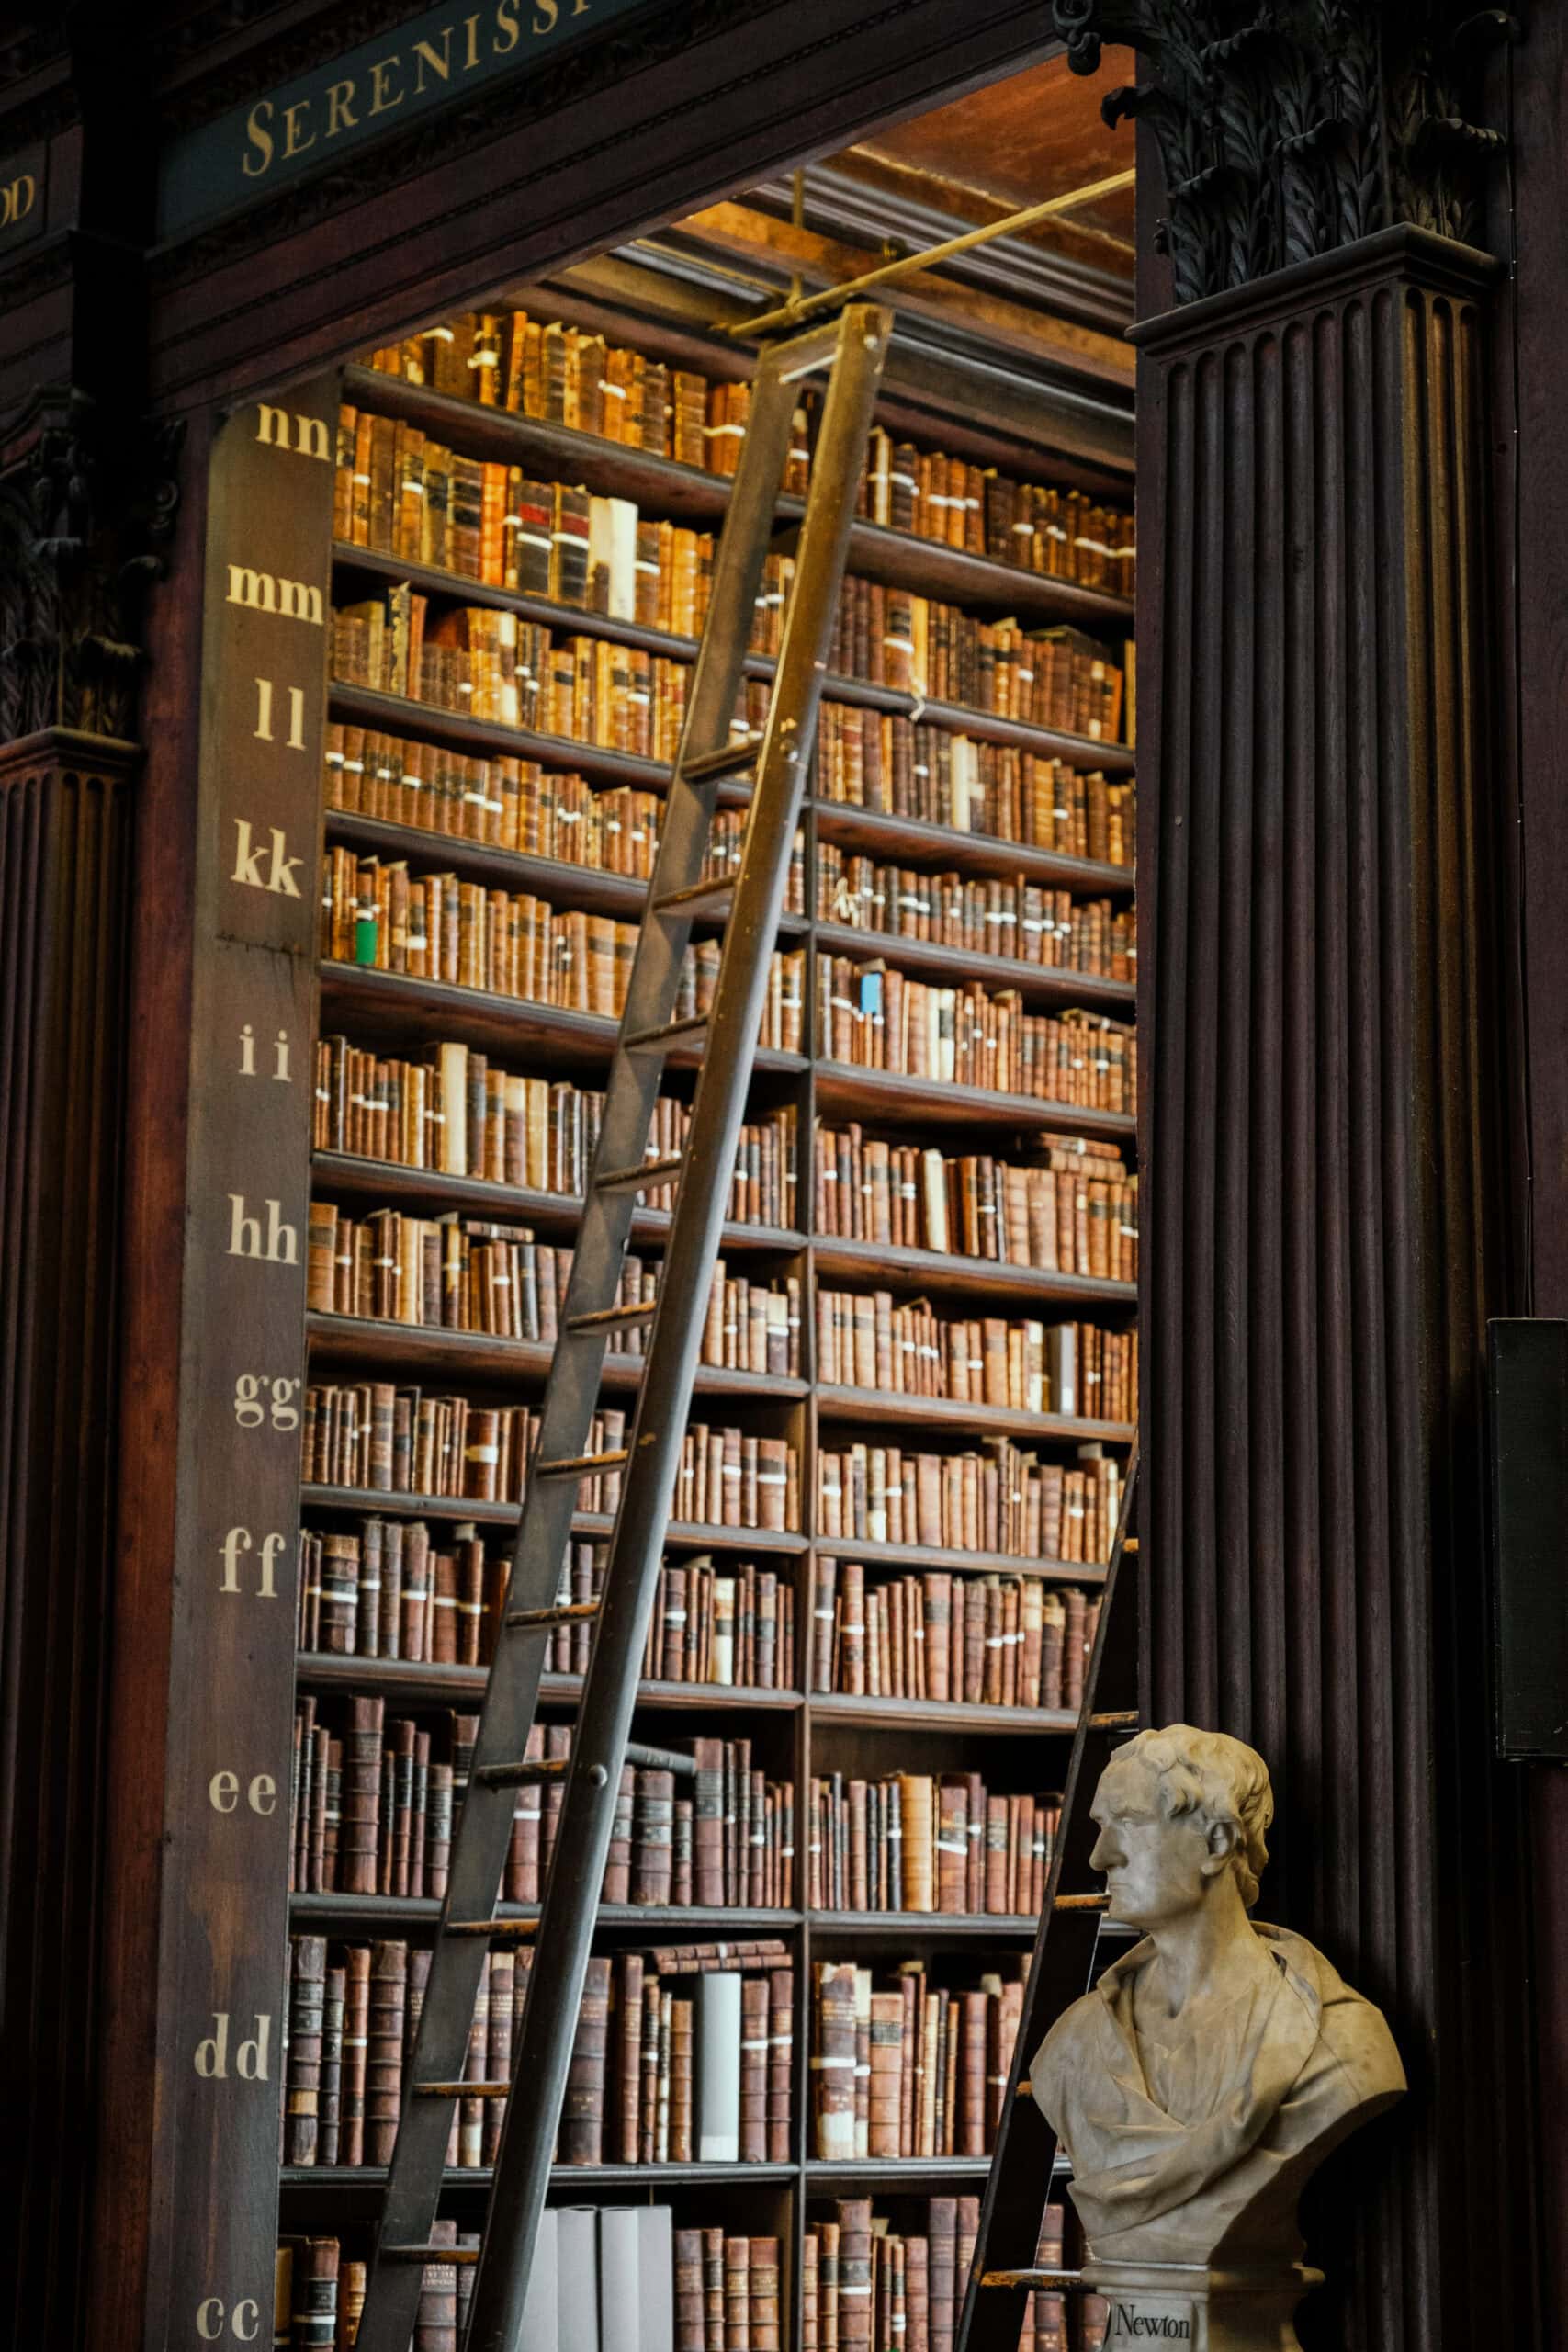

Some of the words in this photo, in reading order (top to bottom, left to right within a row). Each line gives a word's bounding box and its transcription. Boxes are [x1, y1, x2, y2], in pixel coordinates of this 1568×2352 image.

[242, 0, 591, 177] SERENISS
[256, 405, 331, 460] nn
[224, 564, 325, 626] mm
[230, 819, 303, 899] kk
[226, 1193, 299, 1265] hh
[233, 1374, 302, 1431] gg
[218, 1527, 287, 1597] ff
[209, 1770, 276, 1815] ee
[194, 2013, 272, 2081] dd
[196, 2298, 260, 2341] cc
[1115, 2304, 1190, 2339] Newton
